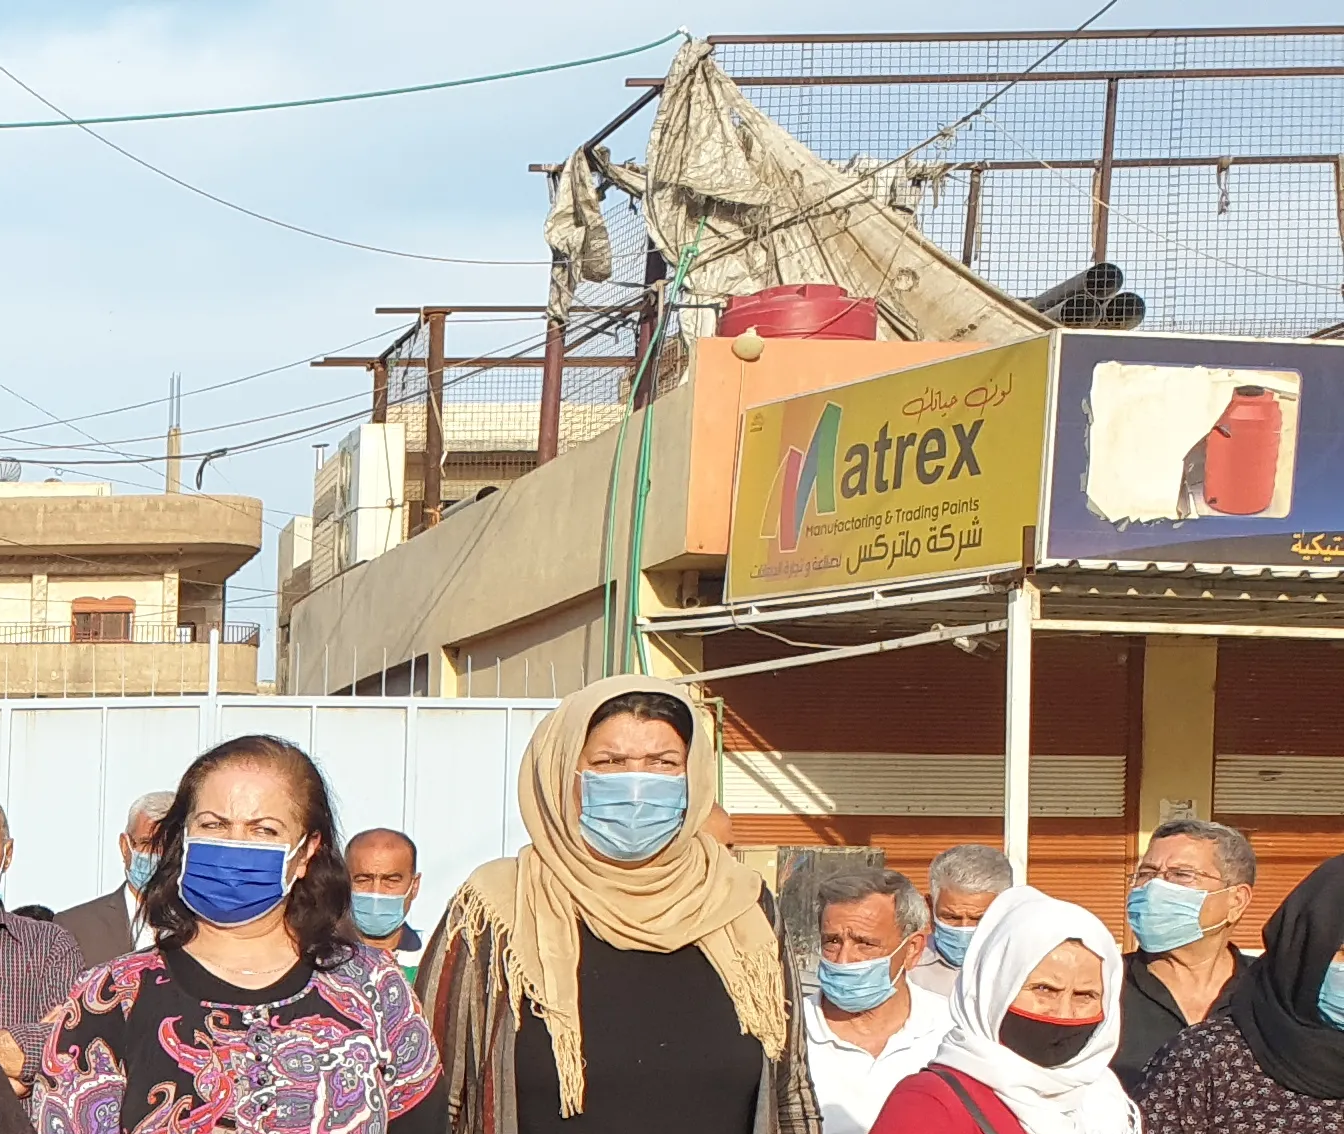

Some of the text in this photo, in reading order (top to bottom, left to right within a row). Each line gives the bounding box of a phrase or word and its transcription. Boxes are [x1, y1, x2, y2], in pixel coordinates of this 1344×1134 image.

[805, 497, 980, 538] Manufactoring & Trading Paints
[926, 516, 983, 562] شركة
[846, 530, 921, 576] ماتركس
